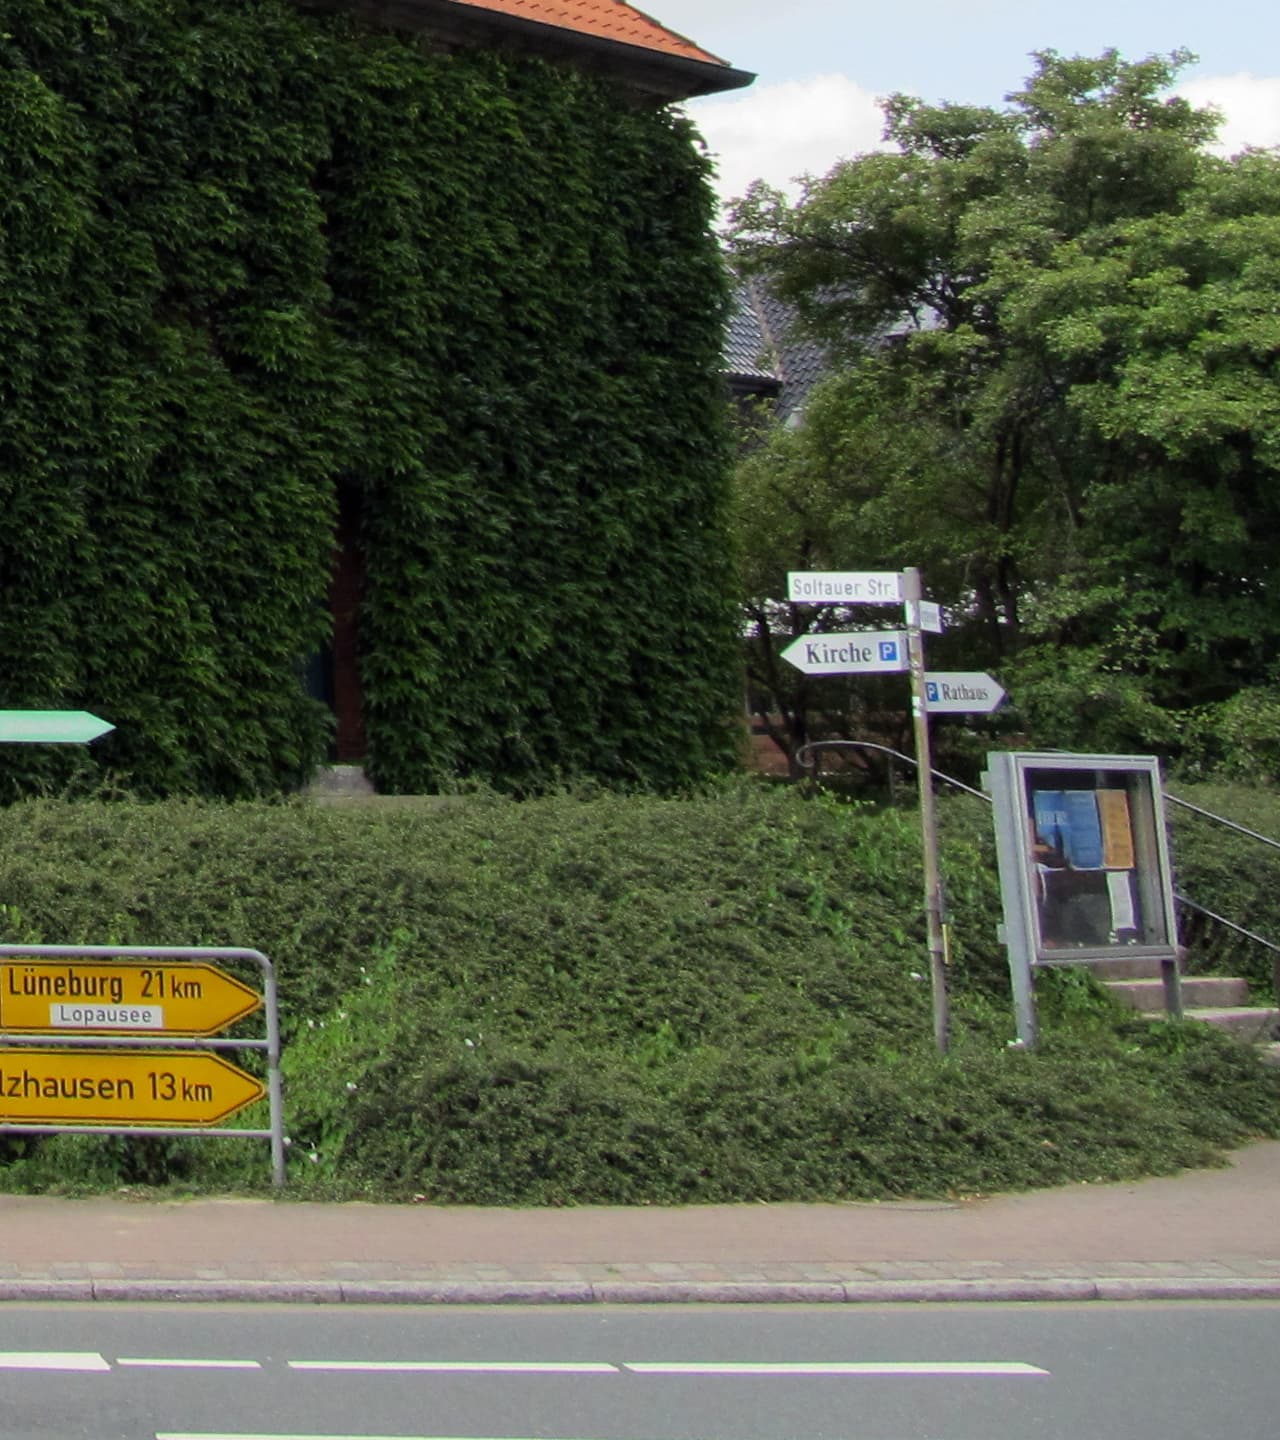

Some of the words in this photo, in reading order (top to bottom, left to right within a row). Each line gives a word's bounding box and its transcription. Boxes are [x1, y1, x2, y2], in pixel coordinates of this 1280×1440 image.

[793, 578, 862, 596] Soltauer
[867, 578, 896, 596] Str.
[805, 642, 873, 664] Kirche
[941, 683, 989, 701] Rathaus
[8, 968, 123, 1003] Lüneburg
[140, 970, 165, 998] 21
[171, 975, 202, 998] km
[60, 1005, 152, 1026] Lopausee
[148, 1071, 177, 1101] 13
[182, 1077, 213, 1102] km
